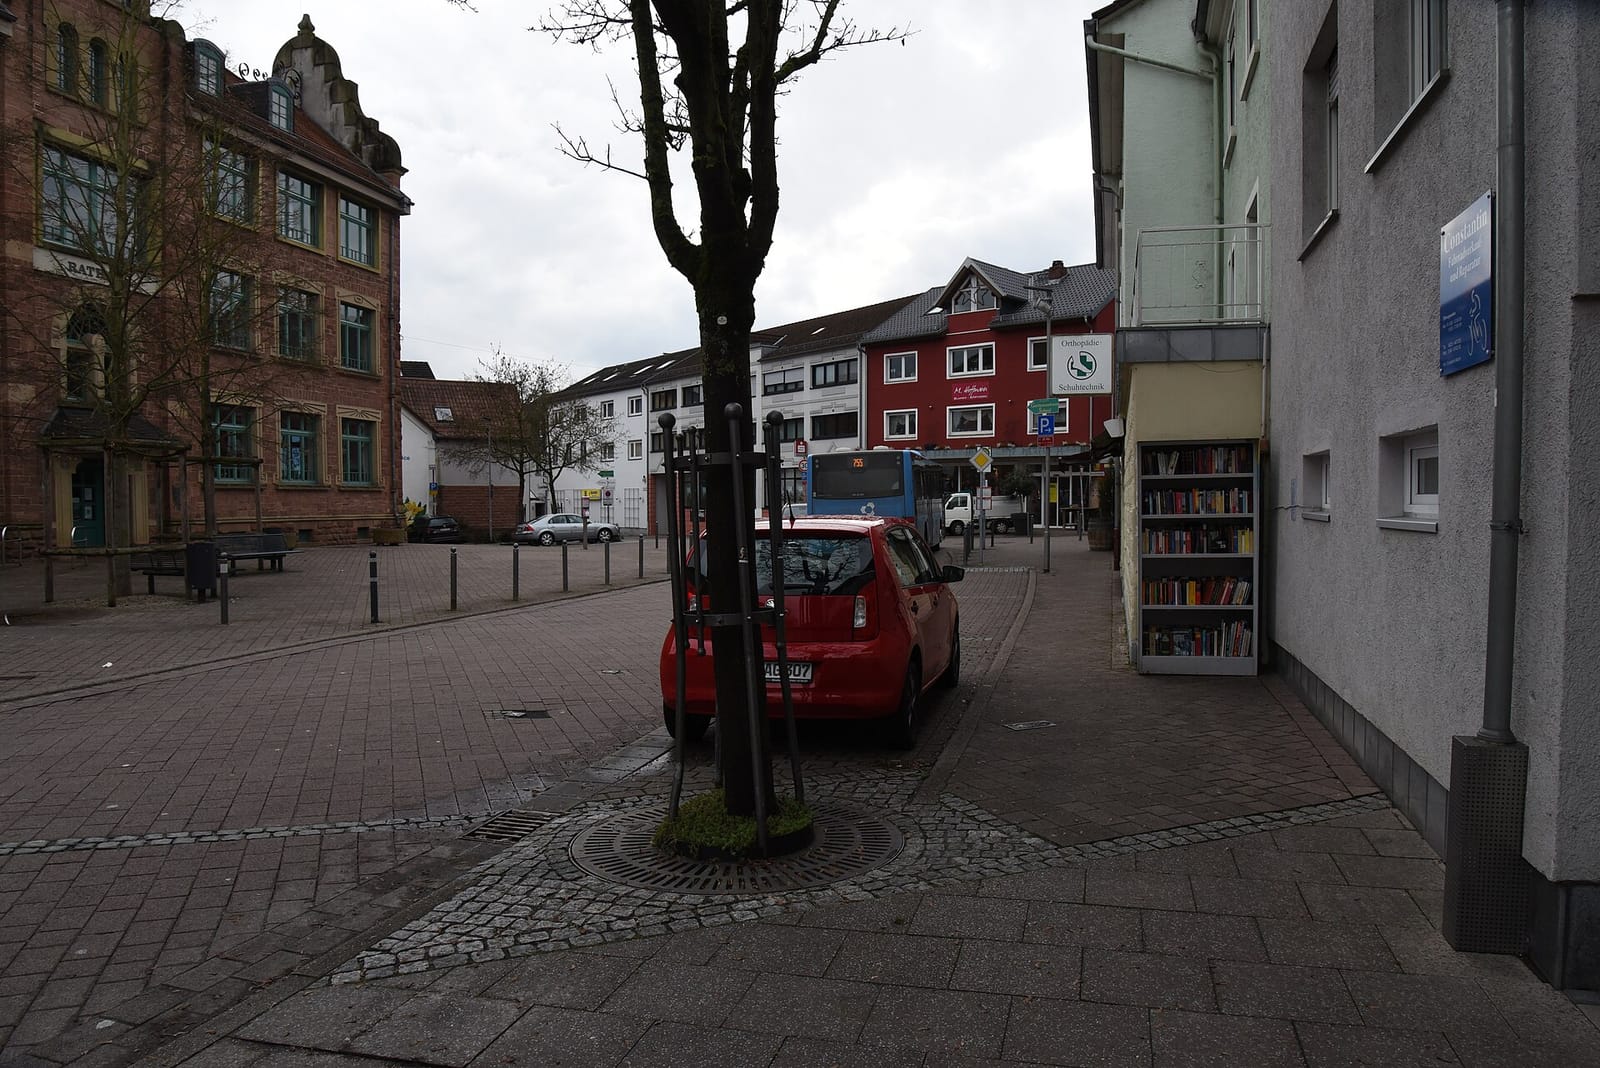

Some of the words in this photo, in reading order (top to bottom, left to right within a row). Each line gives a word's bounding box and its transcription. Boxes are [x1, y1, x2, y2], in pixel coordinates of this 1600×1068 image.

[1444, 209, 1487, 253] Constantin
[1058, 383, 1105, 392] Schuhtechnik
[1040, 418, 1050, 433] P
